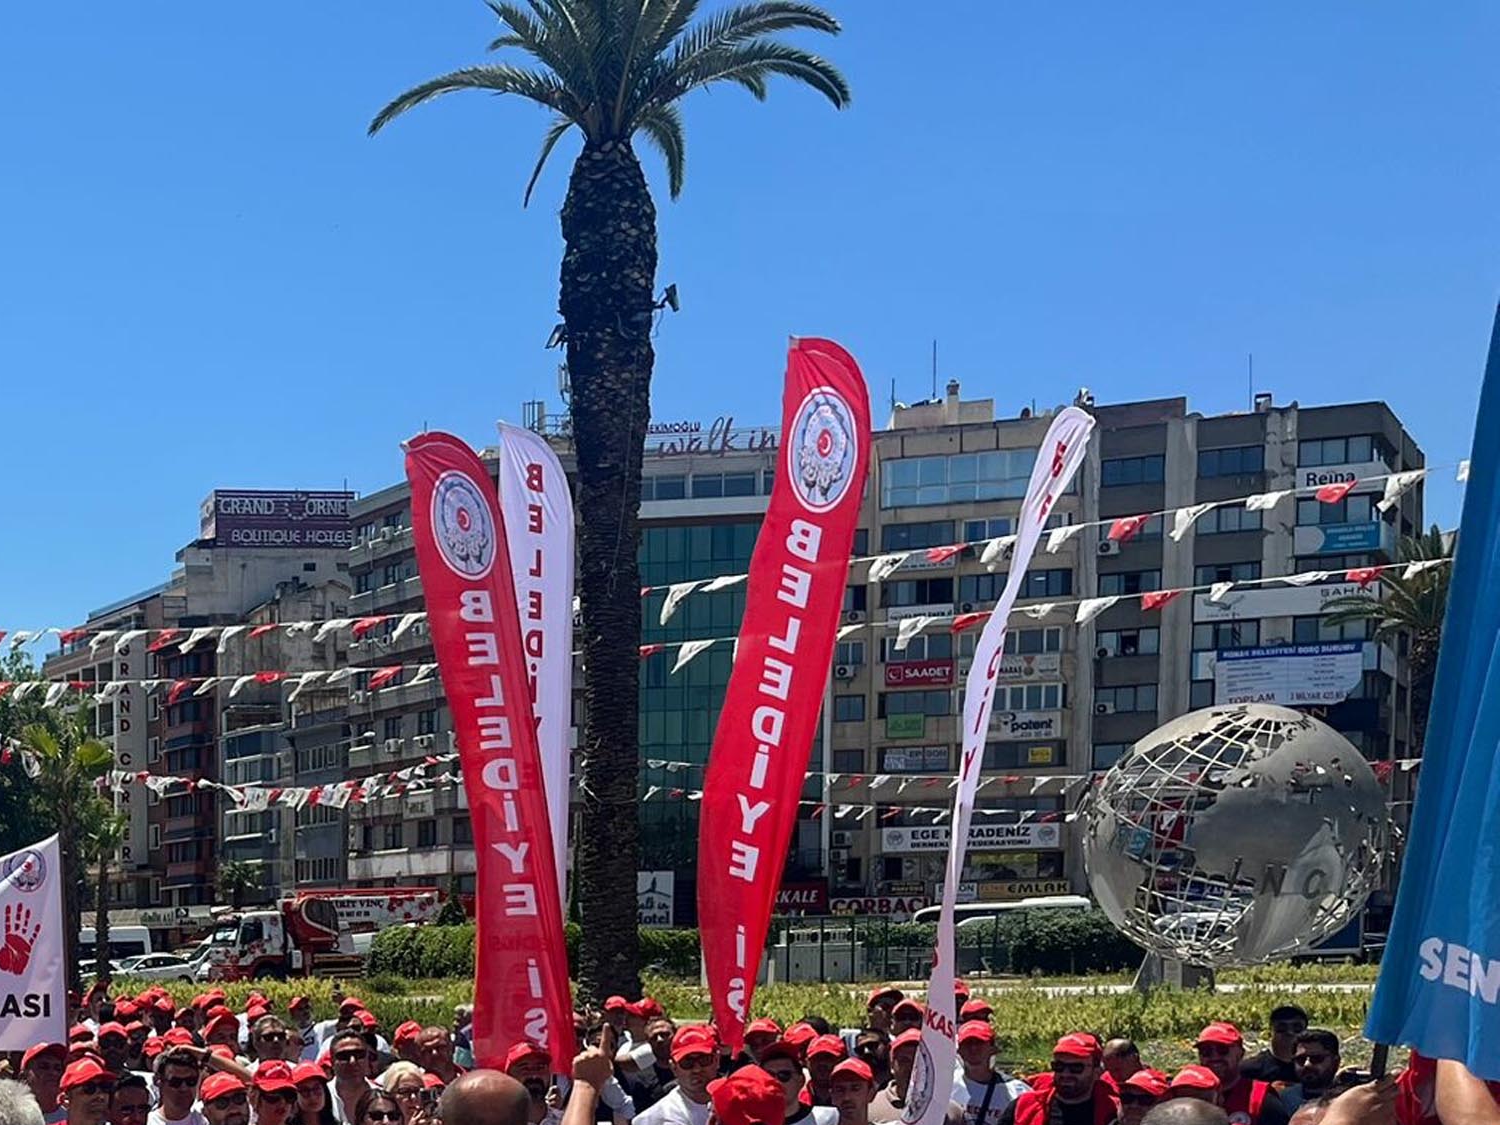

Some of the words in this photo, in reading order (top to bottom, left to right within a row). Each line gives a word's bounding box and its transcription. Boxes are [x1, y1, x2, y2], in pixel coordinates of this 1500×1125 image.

[656, 416, 738, 459] walk
[220, 499, 275, 515] GRAND
[231, 529, 300, 543] BOUTIQUE
[905, 666, 951, 678] SAADET
[1011, 718, 1053, 733] patent
[911, 829, 940, 841] EGE
